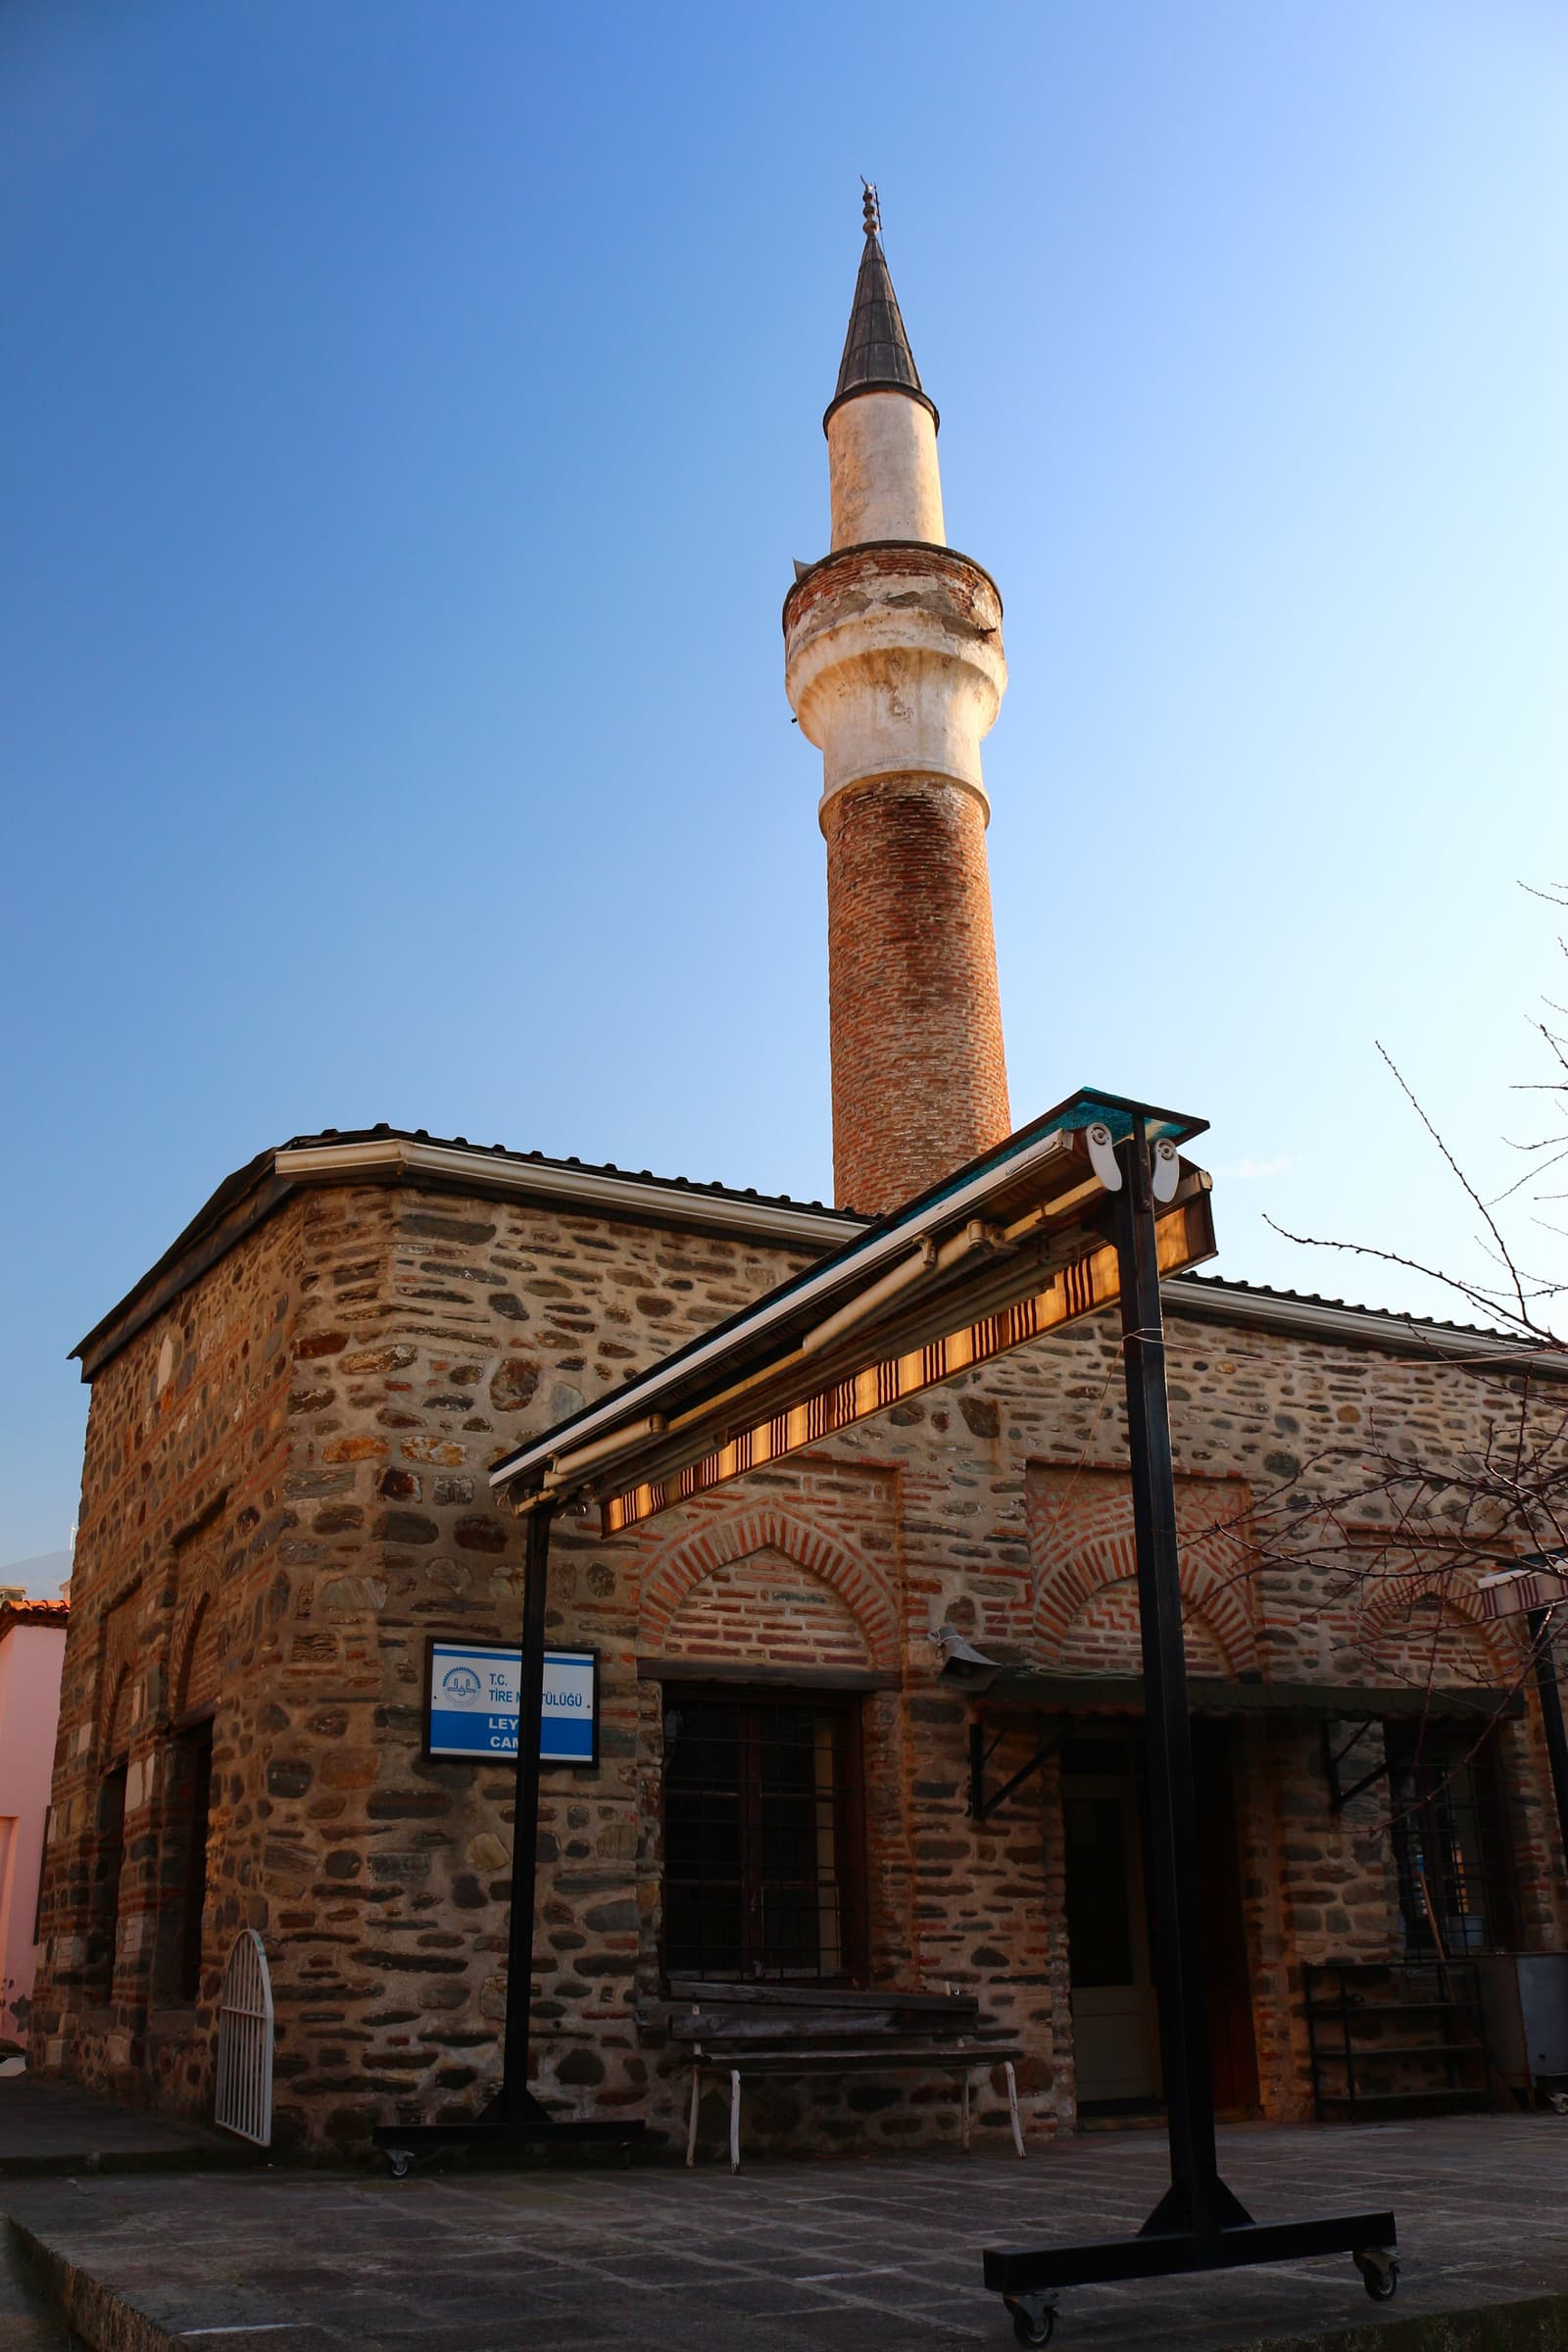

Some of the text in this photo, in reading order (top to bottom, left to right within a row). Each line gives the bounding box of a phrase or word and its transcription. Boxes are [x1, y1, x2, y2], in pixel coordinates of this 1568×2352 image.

[489, 1673, 508, 1687] T.C.
[488, 1688, 513, 1703] TİRE
[488, 1716, 519, 1732] LEY
